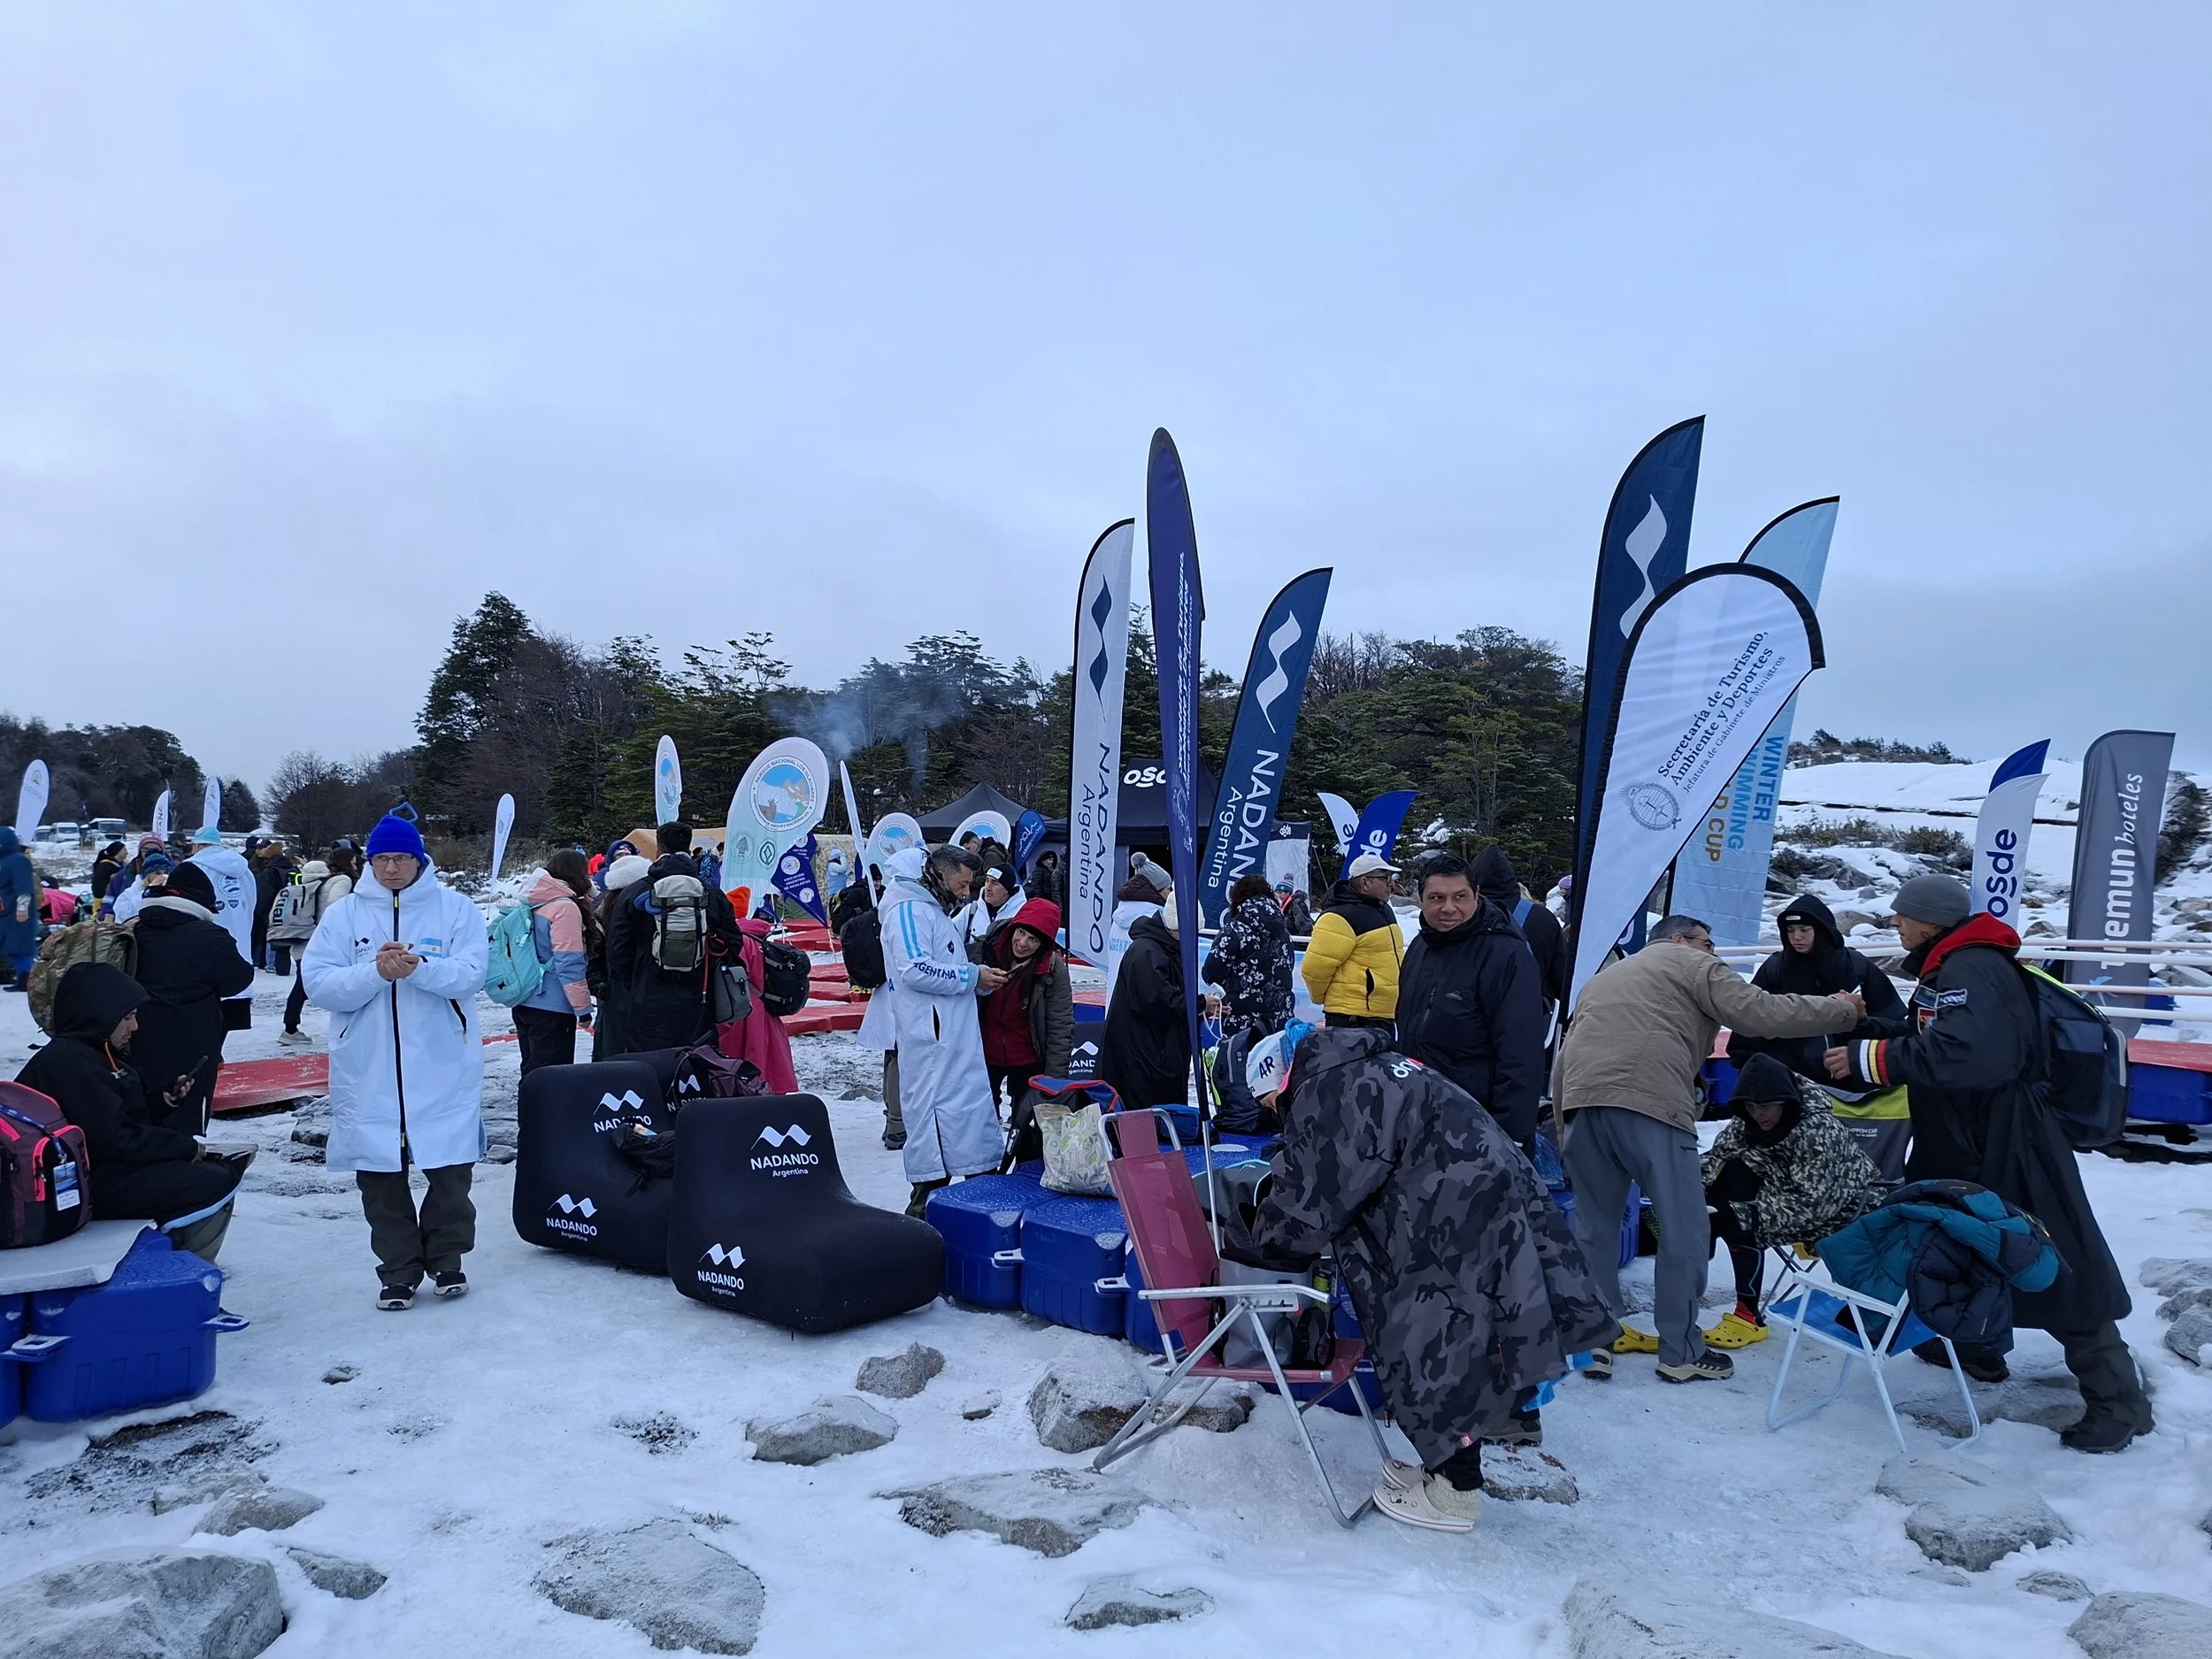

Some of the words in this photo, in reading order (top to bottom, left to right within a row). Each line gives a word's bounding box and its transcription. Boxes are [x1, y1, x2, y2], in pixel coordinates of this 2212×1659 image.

[1657, 710, 1711, 778] Secretaría
[1707, 690, 1724, 708] de
[1718, 631, 1770, 688] Turismo,
[1721, 647, 1774, 710] Deportes
[1683, 762, 1710, 794] Jefatura
[1709, 749, 1717, 759] de
[1716, 709, 1746, 747] Gabinete
[1744, 696, 1755, 708] de
[1750, 655, 1786, 696] Ministros
[1717, 710, 1730, 723] y
[1671, 721, 1719, 786] Ambiente
[1752, 735, 1785, 822] WINTER
[1726, 747, 1758, 850] WIMMING
[2114, 772, 2144, 845] hoteles
[1078, 784, 1096, 899] Argentina
[1089, 742, 1110, 954] NADANDO
[1208, 786, 1243, 888] Argentina
[1704, 818, 1725, 862] CUP
[1985, 828, 2018, 919] osde
[749, 1153, 819, 1171] NADANDO
[772, 1167, 809, 1178] Argentina
[546, 1217, 597, 1237] NADANDO
[561, 1231, 588, 1242] Argentina
[697, 1271, 745, 1291] NADANDO
[711, 1286, 736, 1297] Argentina
